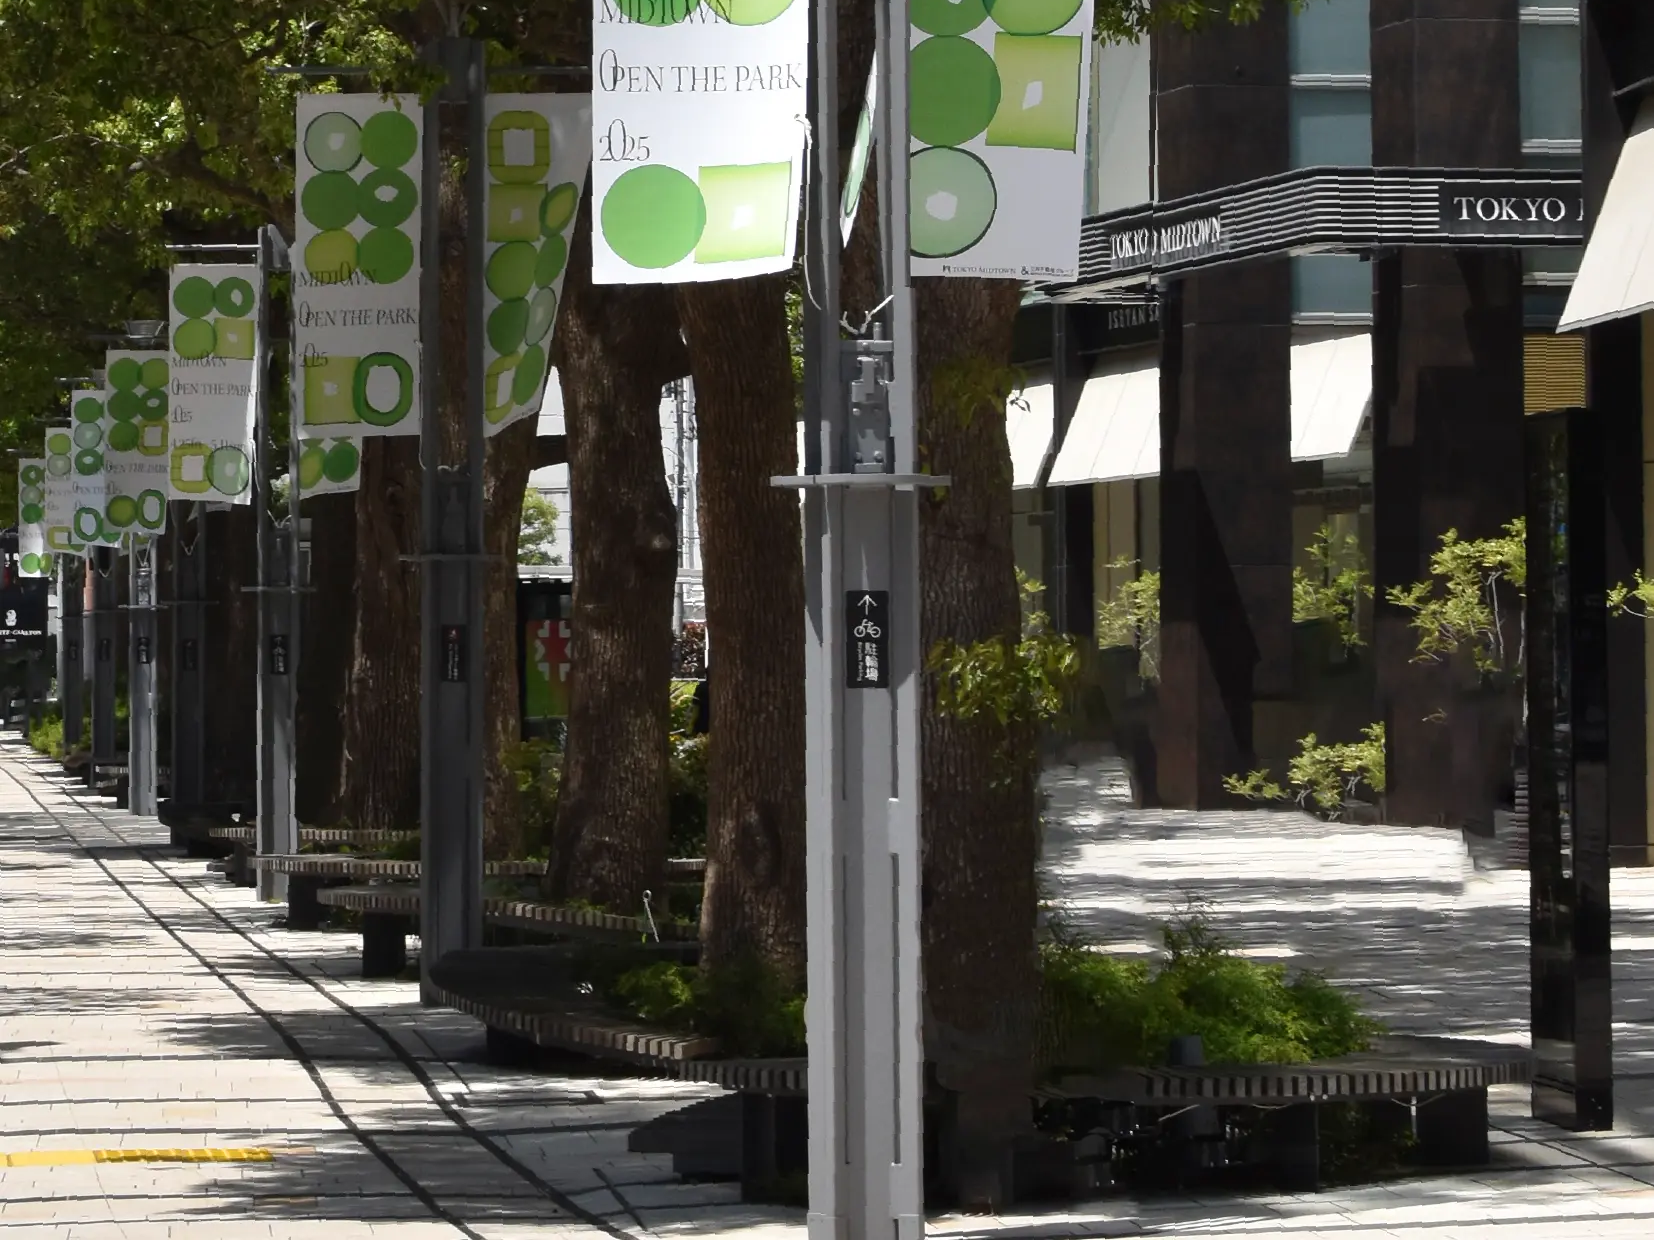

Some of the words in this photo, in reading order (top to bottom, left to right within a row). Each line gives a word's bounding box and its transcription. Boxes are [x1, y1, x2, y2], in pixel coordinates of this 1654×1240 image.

[599, 48, 665, 93] OPEN
[671, 64, 727, 93] THE
[735, 62, 803, 92] PARK
[599, 118, 651, 162] 2025
[1453, 197, 1566, 222] TOKYO
[1110, 228, 1149, 260] TOKYO
[1160, 216, 1220, 255] MIDTOWN
[298, 261, 377, 287] MIDTOWN
[299, 301, 336, 327] OPEN
[340, 309, 373, 327] THE
[376, 307, 417, 326] PARK
[1108, 306, 1146, 330] ISETAN
[171, 377, 198, 396] OPEN
[201, 383, 225, 395] THE
